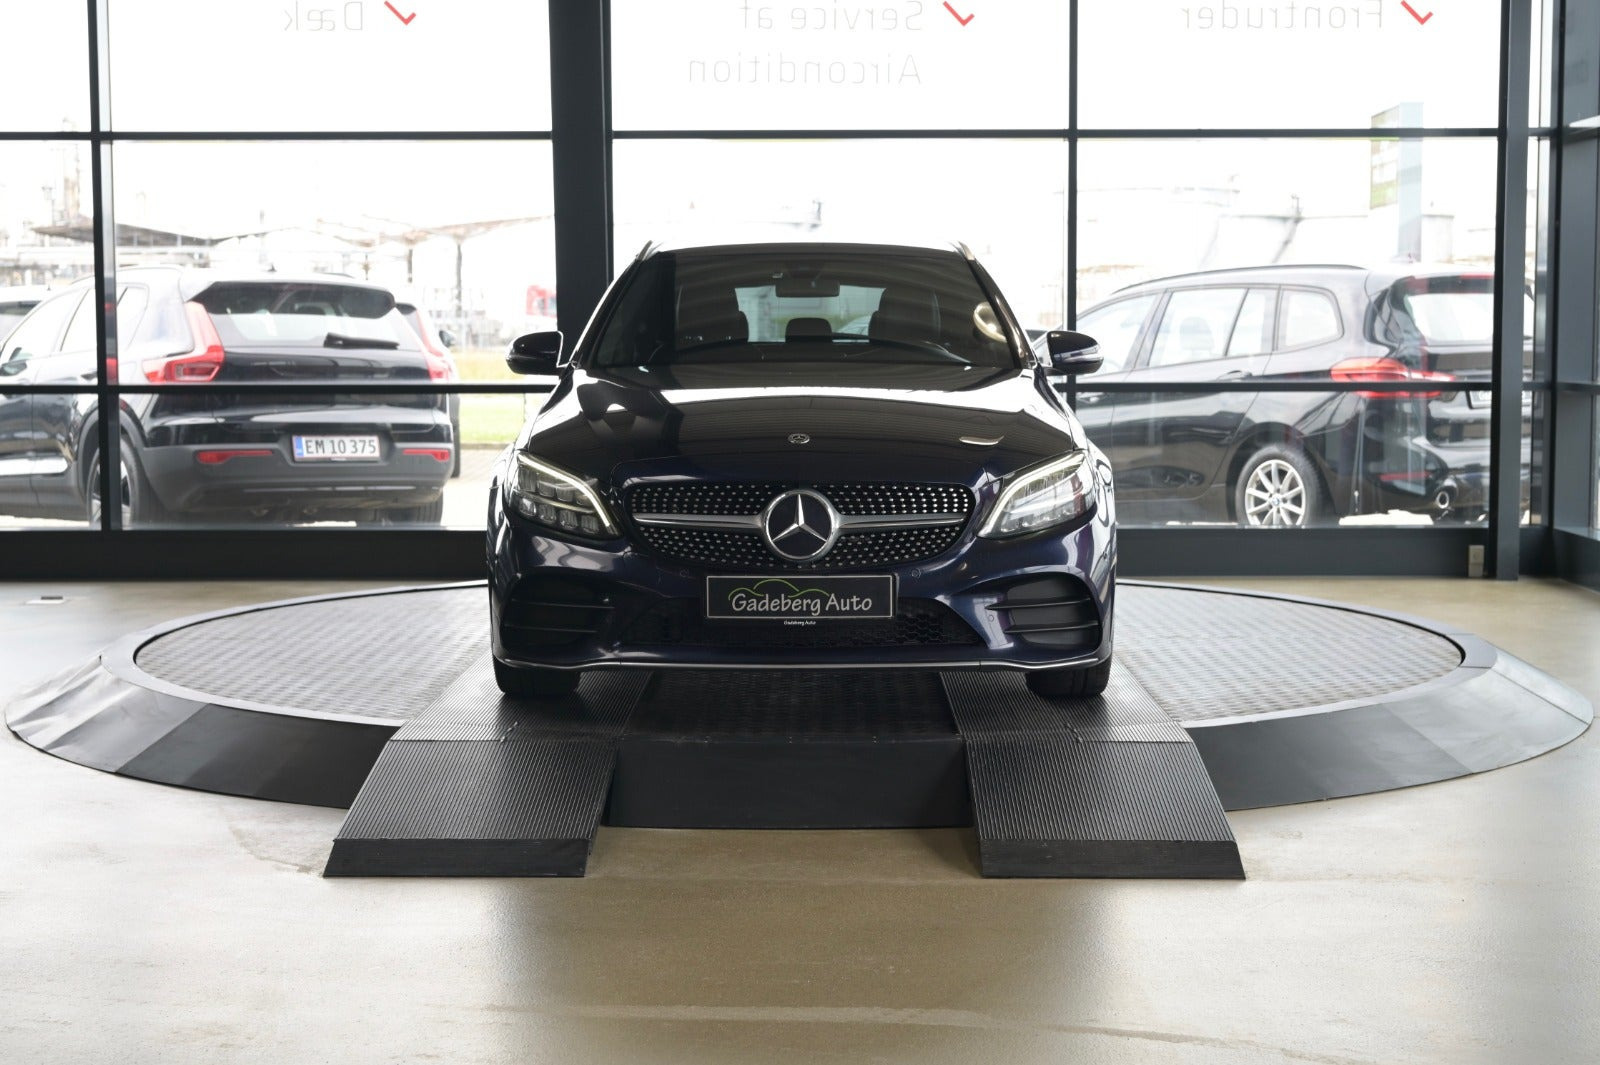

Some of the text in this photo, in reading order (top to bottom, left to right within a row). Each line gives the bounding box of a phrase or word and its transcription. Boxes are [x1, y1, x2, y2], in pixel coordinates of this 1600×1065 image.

[305, 439, 376, 454] EM 10 375
[731, 593, 872, 616] Gadeberg Auto
